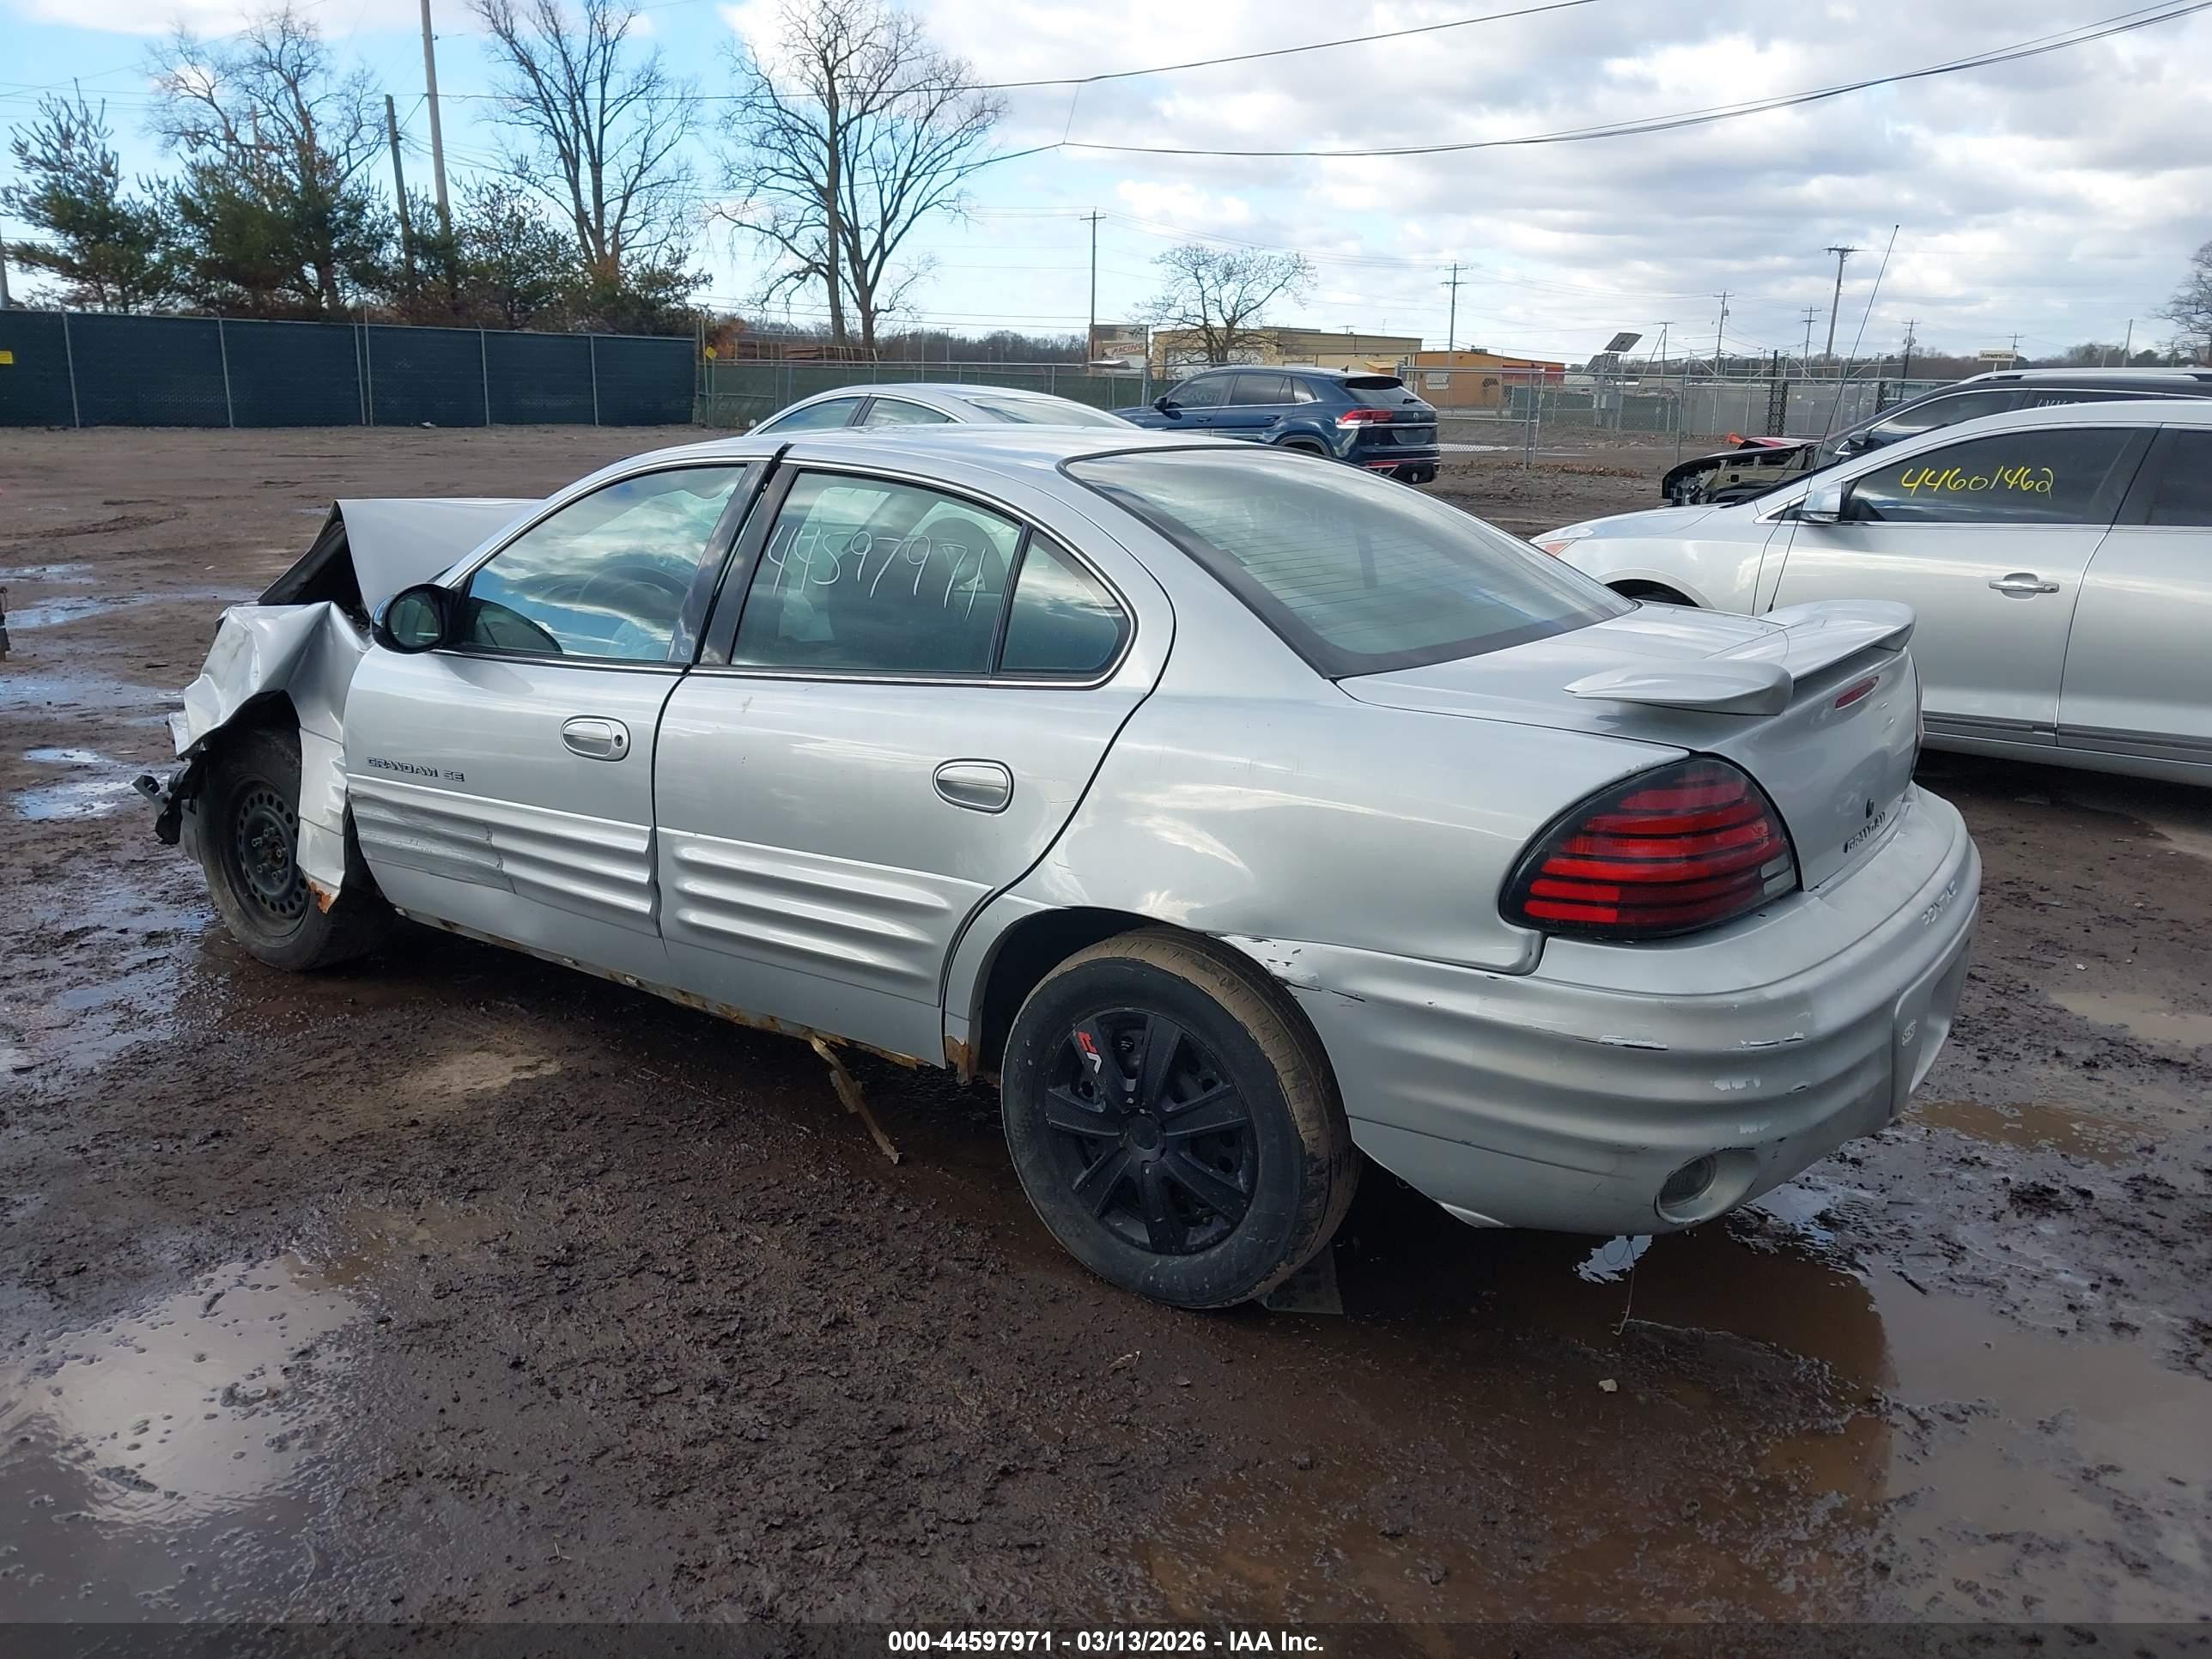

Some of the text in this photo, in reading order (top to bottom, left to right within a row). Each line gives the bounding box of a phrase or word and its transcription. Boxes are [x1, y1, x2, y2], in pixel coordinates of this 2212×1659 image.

[1900, 465, 2054, 500] 44601462
[767, 524, 988, 621] 44597971
[367, 757, 414, 774] GRAND
[442, 769, 465, 782] SE
